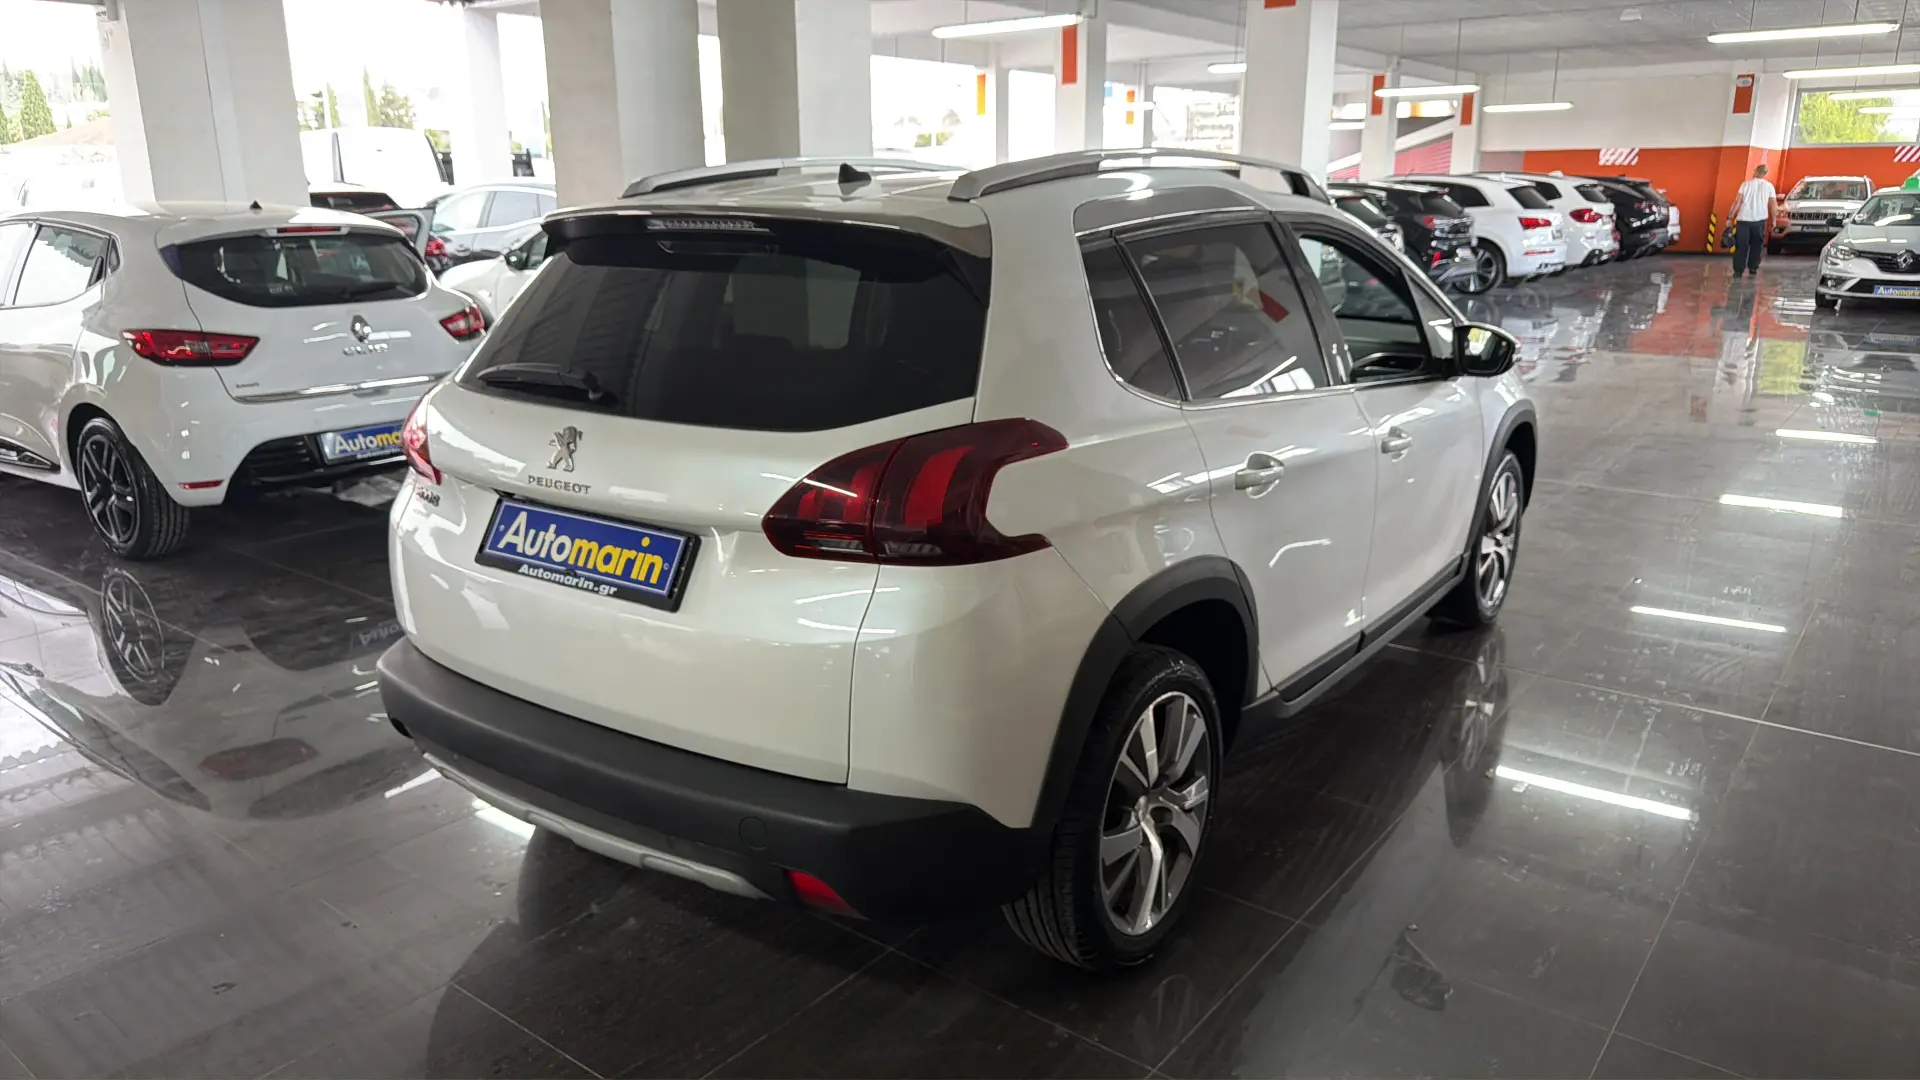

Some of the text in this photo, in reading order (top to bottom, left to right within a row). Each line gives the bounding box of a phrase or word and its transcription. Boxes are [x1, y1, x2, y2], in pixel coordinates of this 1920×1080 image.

[528, 474, 592, 494] PEUGEOT
[500, 511, 663, 584] Automarin
[518, 563, 617, 595] Automarin.gr
